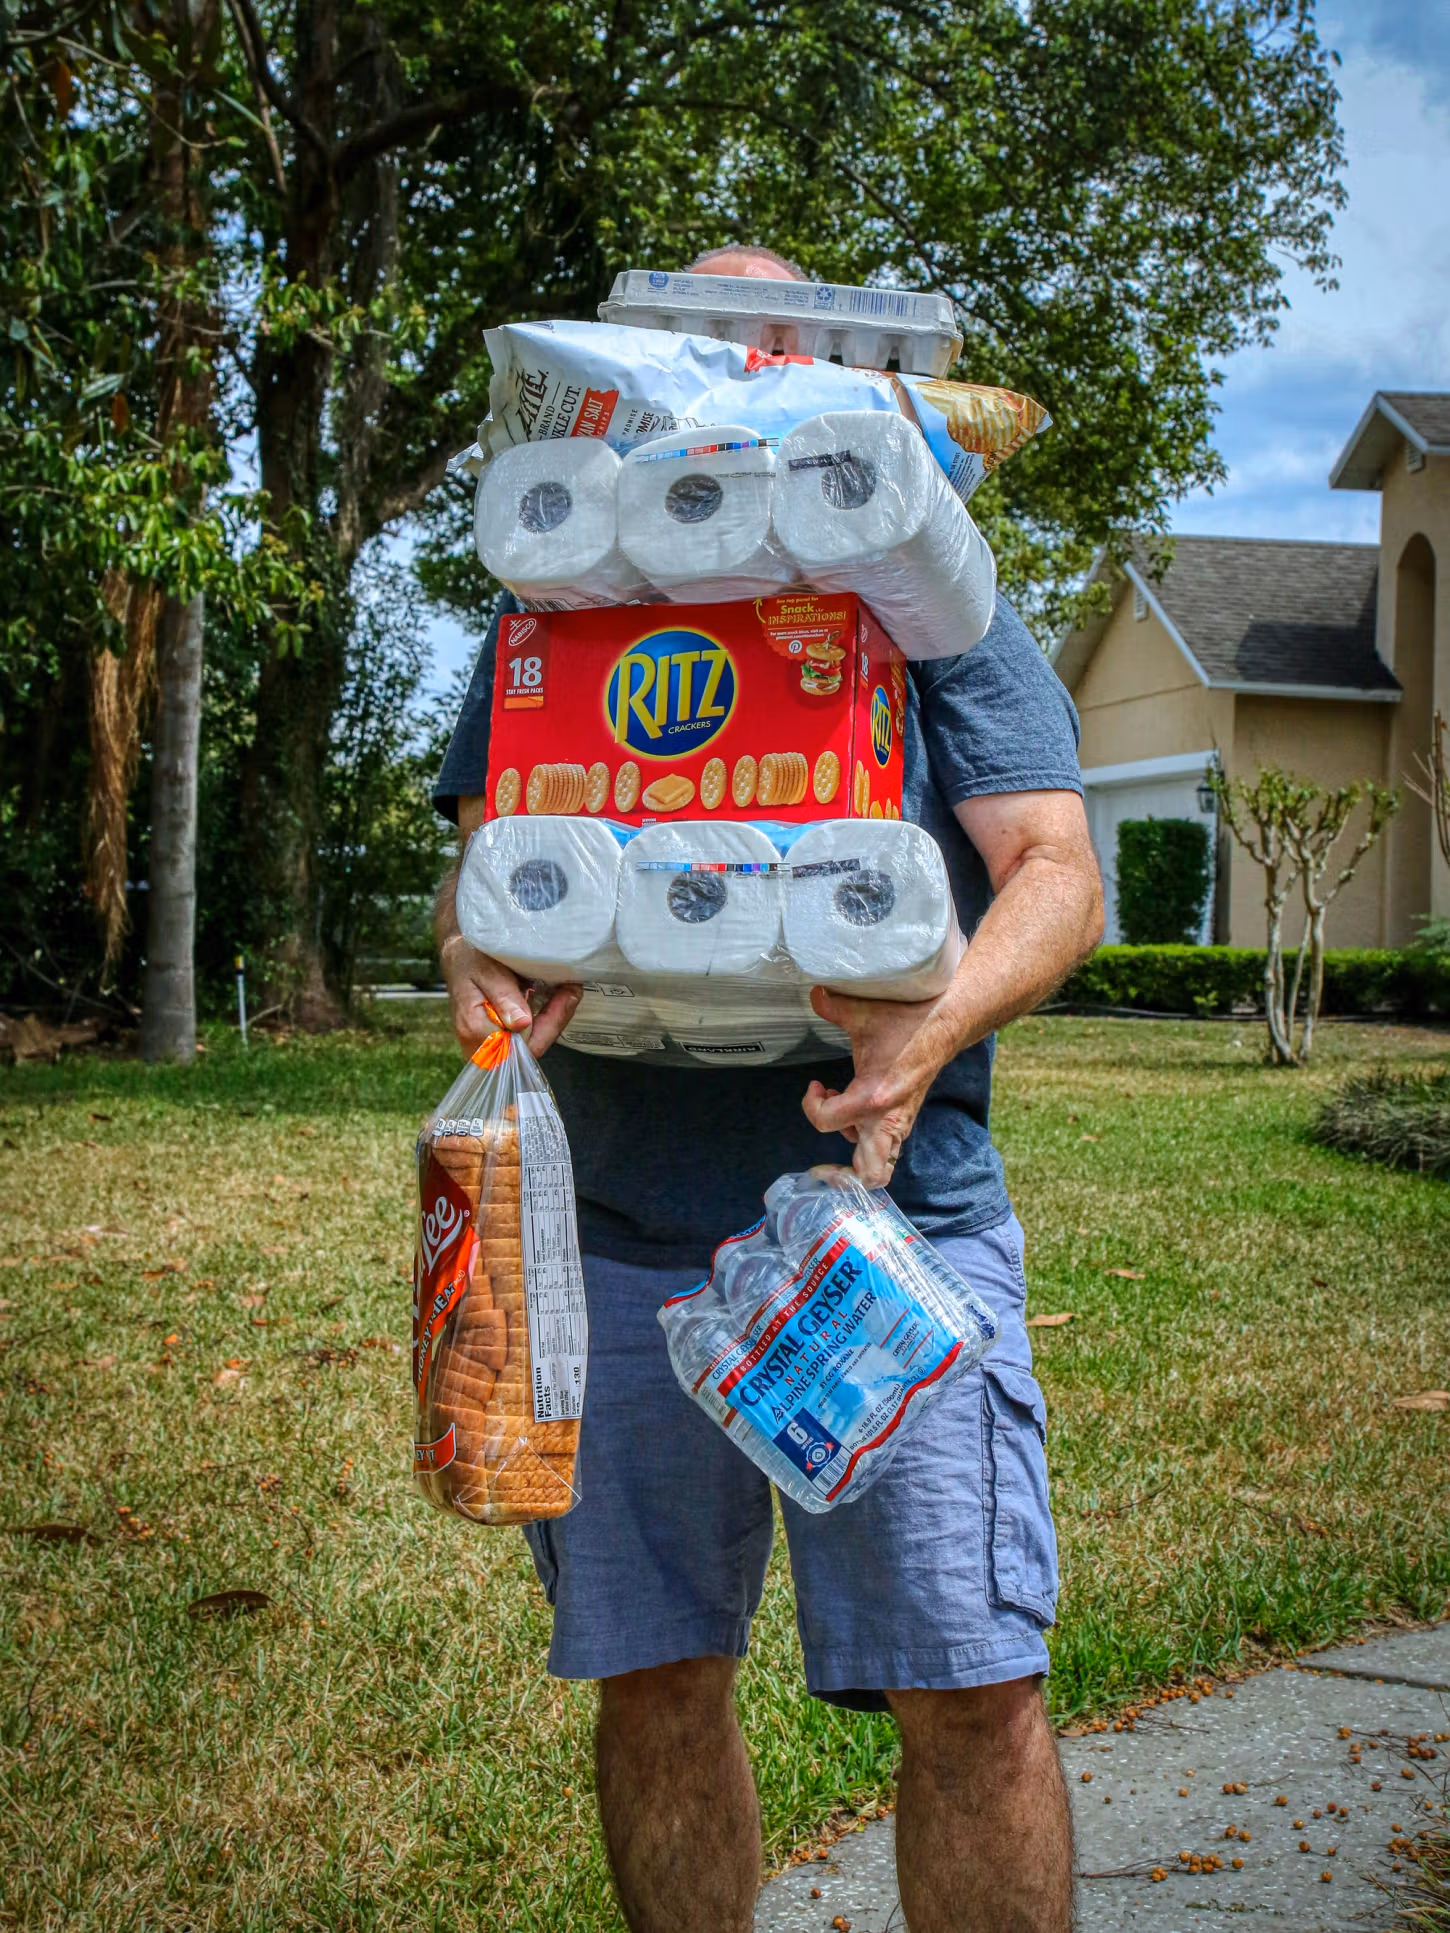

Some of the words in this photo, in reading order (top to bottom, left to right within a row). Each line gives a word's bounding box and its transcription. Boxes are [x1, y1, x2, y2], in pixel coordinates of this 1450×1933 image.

[540, 405, 556, 436] BRAND
[584, 398, 604, 420] SALT
[768, 611, 846, 625] INSPIRATIONS!
[781, 603, 814, 614] Snack
[510, 620, 535, 644] NABISCO
[509, 656, 542, 686] 18
[862, 652, 869, 676] 18
[615, 649, 729, 744] RITZ
[668, 720, 711, 734] CRACKERS
[872, 692, 892, 752] RITZ
[740, 1334, 771, 1372] BOTTLED
[772, 1320, 782, 1332] AT
[783, 1300, 801, 1318] THE
[802, 1262, 829, 1298] SOURCE
[740, 1334, 805, 1406] CRYSTAL
[798, 1260, 864, 1336] GEYSER
[806, 1332, 848, 1380] SPRING
[842, 1290, 877, 1335] WATER
[418, 1326, 432, 1382] HONEY
[784, 1311, 848, 1386] NATURAL
[712, 1353, 738, 1380] CRYSTAL
[820, 1381, 828, 1390] BY
[826, 1372, 834, 1381] CG
[832, 1348, 854, 1372] ROXANE
[536, 1367, 544, 1418] Nutrition
[866, 1424, 878, 1438] 101.5
[876, 1418, 883, 1426] FL
[882, 1412, 889, 1422] OZ
[870, 1412, 878, 1420] FL
[876, 1402, 884, 1413] OZ
[786, 1422, 808, 1445] 6
